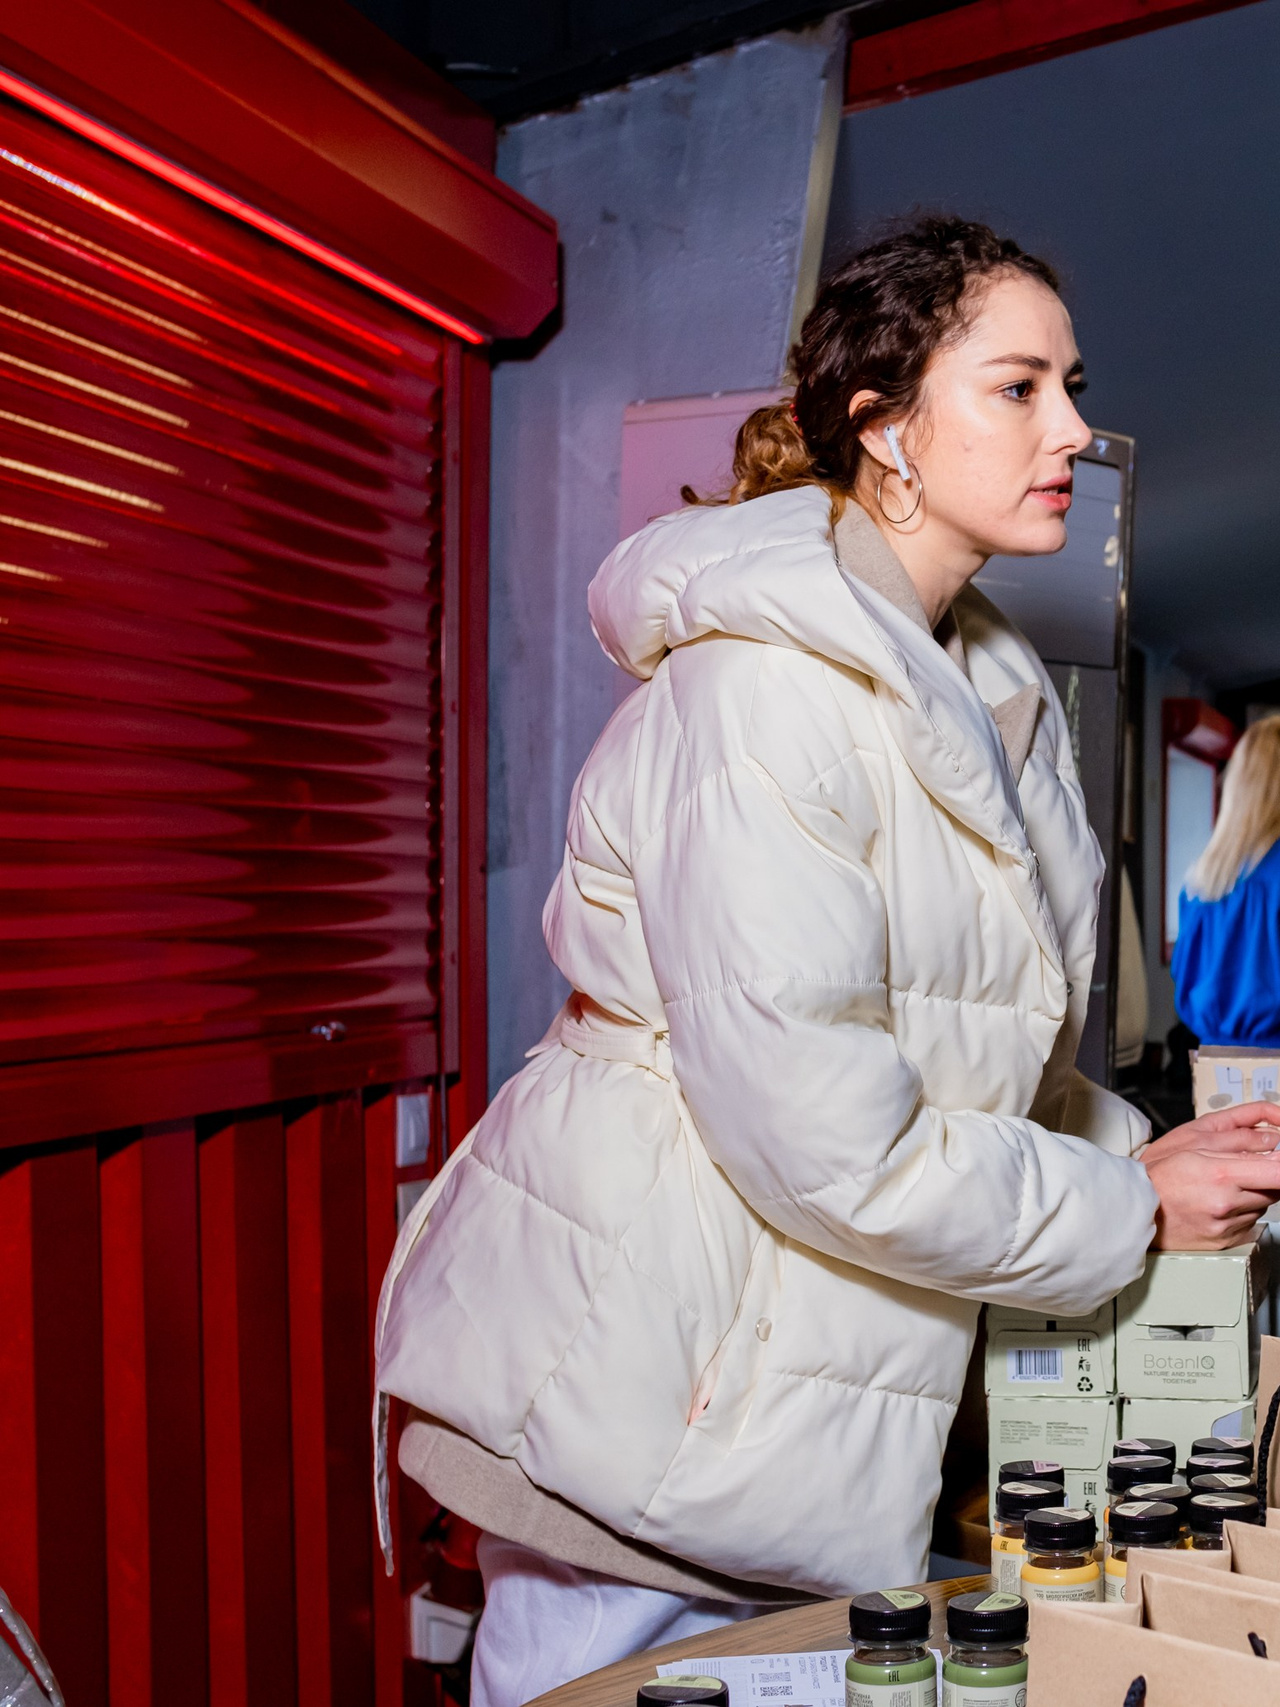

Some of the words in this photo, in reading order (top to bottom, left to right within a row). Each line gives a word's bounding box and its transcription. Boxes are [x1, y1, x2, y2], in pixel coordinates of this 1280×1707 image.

[1077, 1339, 1091, 1352] EAC
[1143, 1353, 1215, 1370] BotanIQ
[1083, 1482, 1097, 1495] EAC
[888, 1670, 900, 1682] EAC
